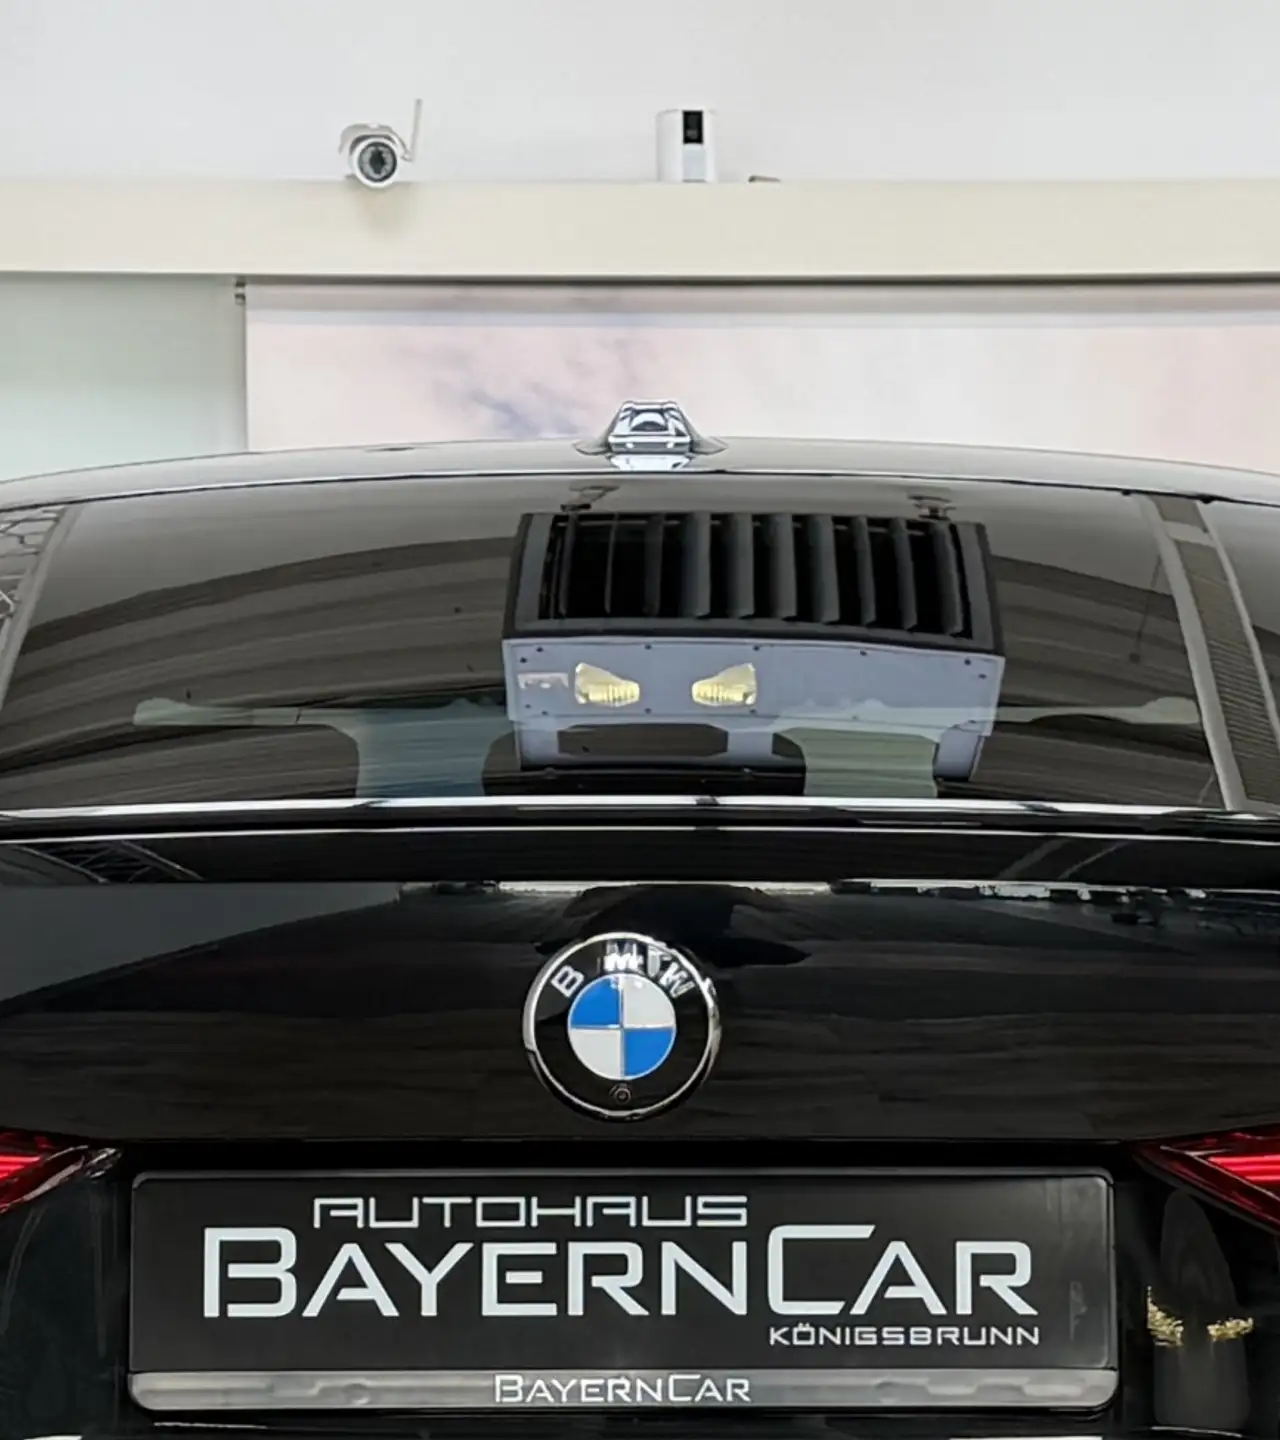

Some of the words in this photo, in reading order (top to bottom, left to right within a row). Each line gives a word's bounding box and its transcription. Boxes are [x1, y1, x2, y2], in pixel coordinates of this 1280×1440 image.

[550, 940, 698, 998] BMW
[313, 1195, 748, 1228] AUTOHAUS
[203, 1224, 1039, 1318] BAYERNCAR
[768, 1322, 1040, 1346] KÖNIGSBRUNN
[494, 1373, 751, 1404] BAYERNCAR
